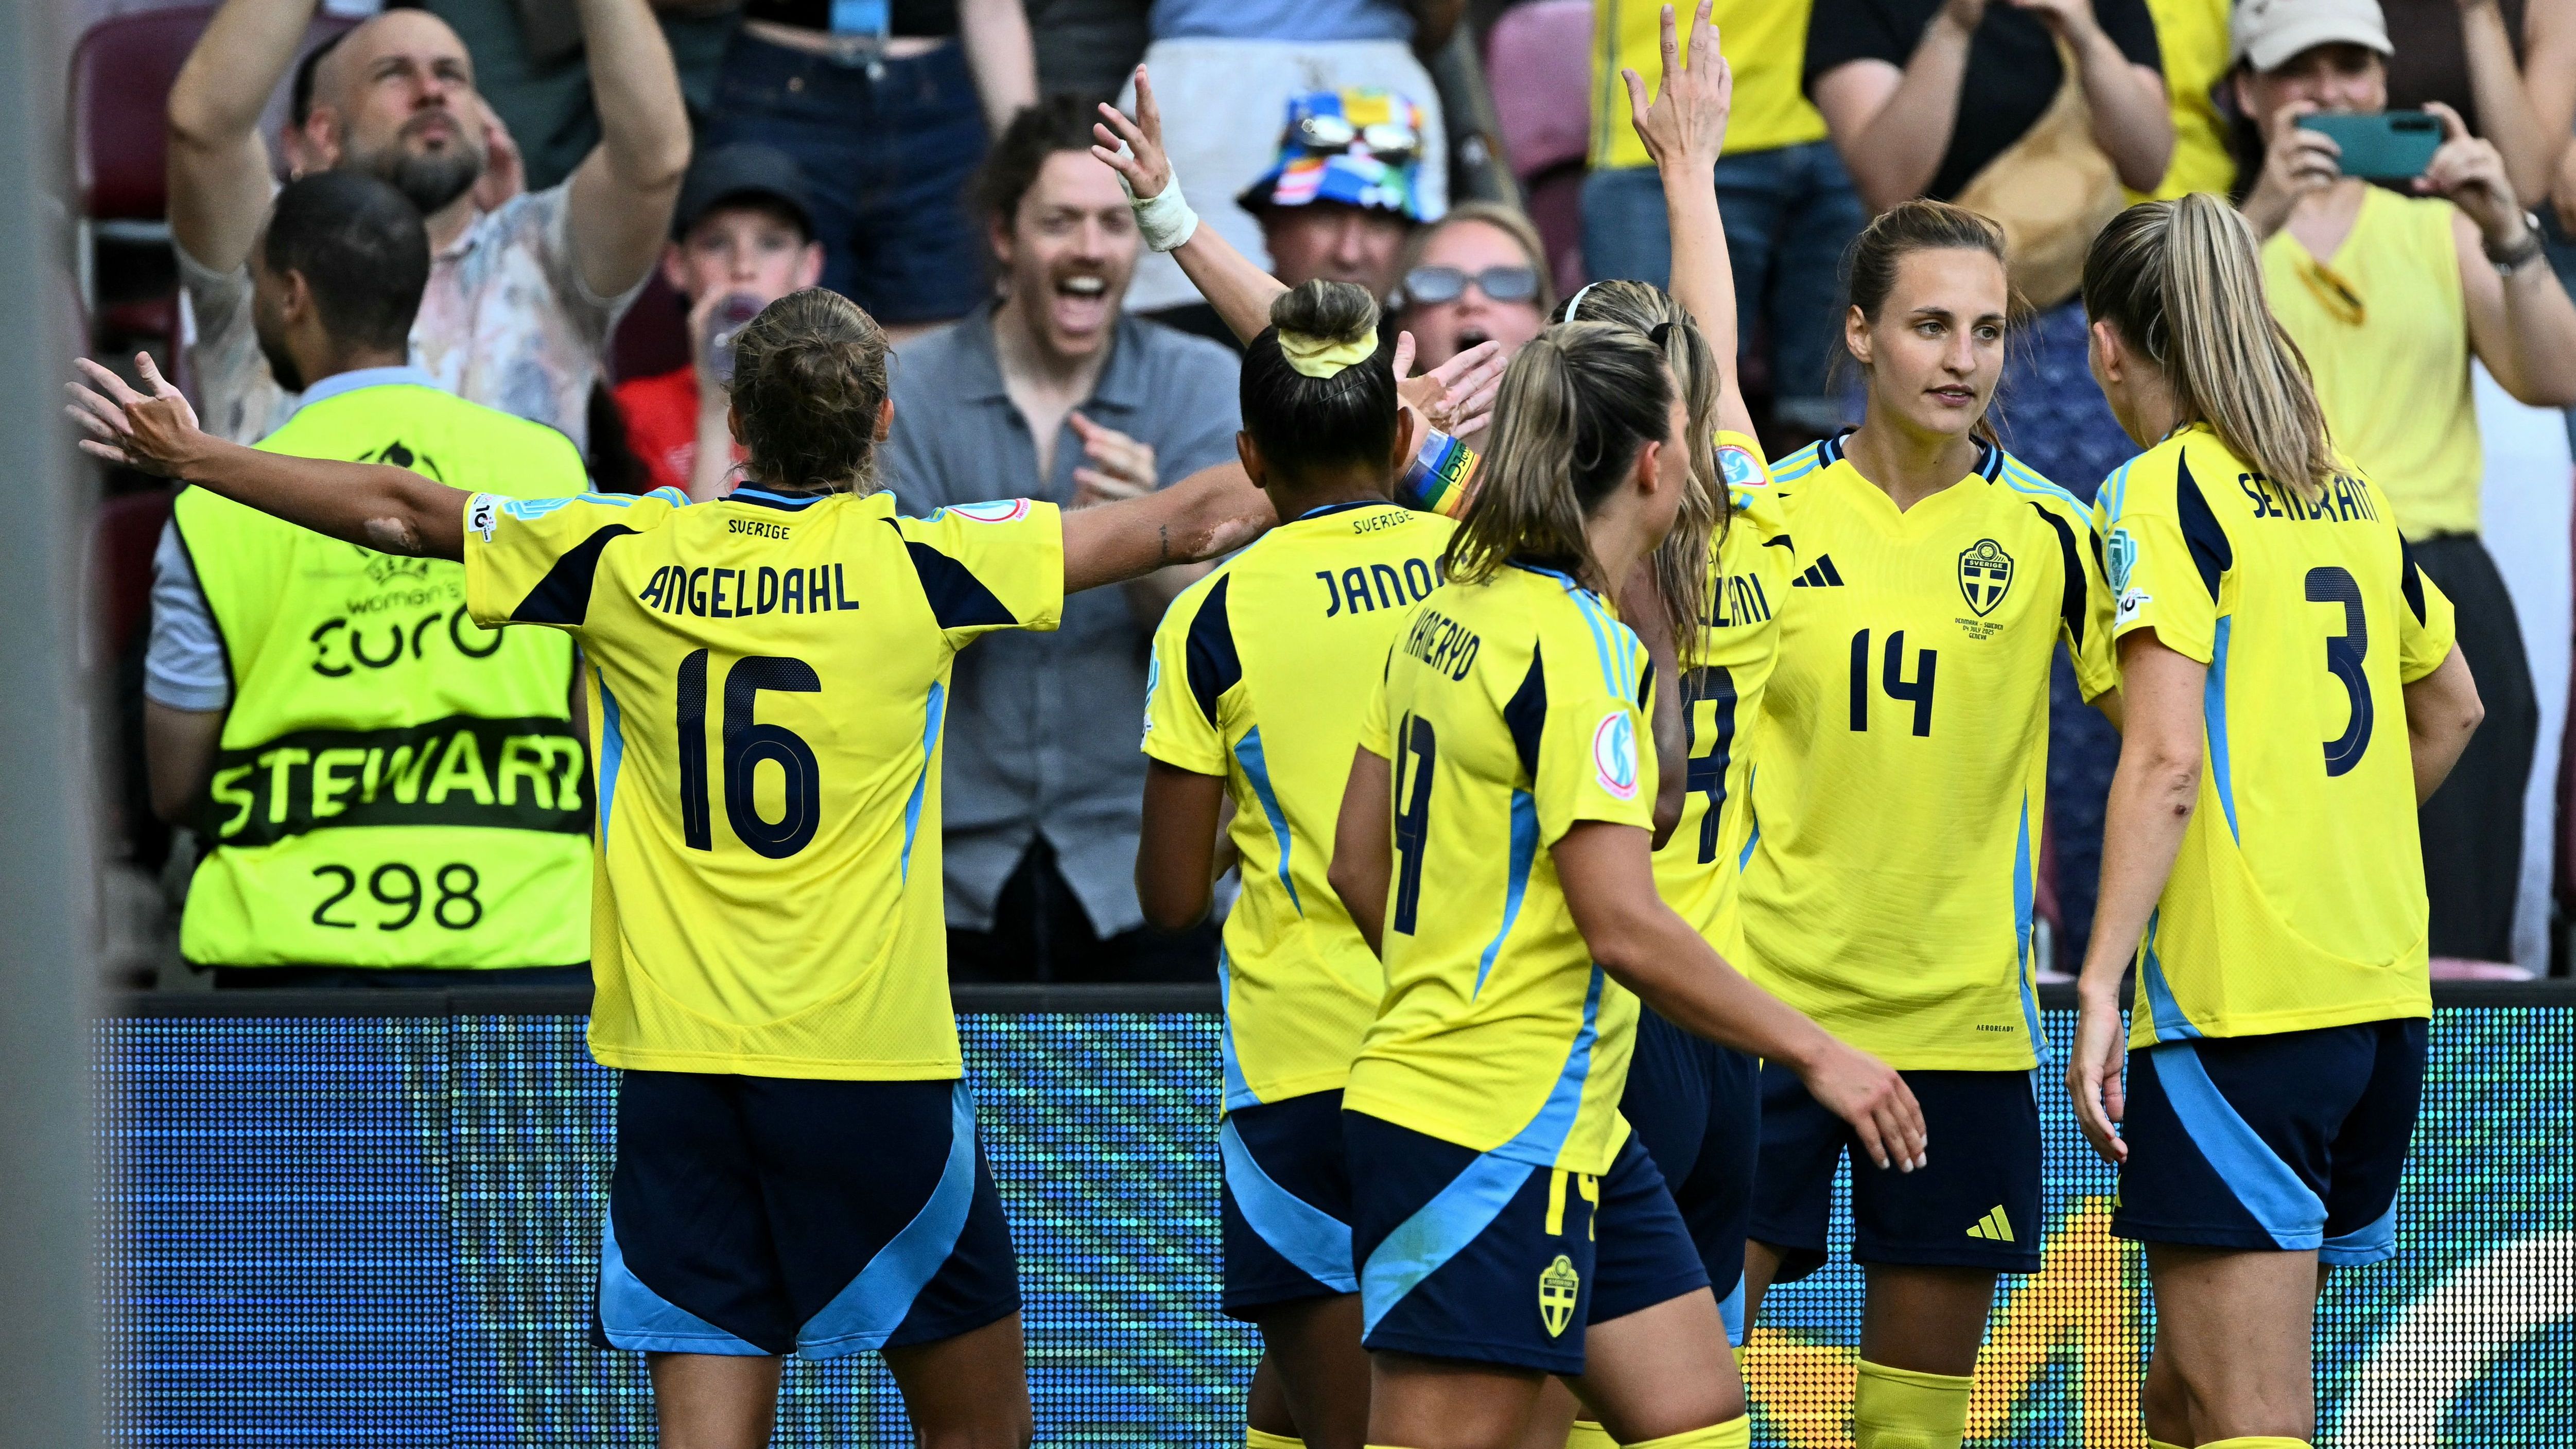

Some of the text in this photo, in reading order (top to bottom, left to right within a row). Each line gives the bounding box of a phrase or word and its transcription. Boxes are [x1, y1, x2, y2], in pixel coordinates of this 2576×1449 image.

[728, 519, 791, 540] SVERIGE
[1353, 509, 1415, 535] SVERIGE
[640, 563, 859, 618] ANGELDAHL
[1315, 553, 1467, 618] JANO
[1970, 560, 2003, 568] SVERIGE
[1955, 618, 1978, 626] DENMARK
[1984, 622, 2004, 631] SWEDEN
[1850, 628, 1938, 737] 14
[2305, 567, 2374, 777] 3
[211, 730, 585, 838] STEWARD
[677, 649, 821, 859] 16
[1679, 666, 1738, 864] 9
[311, 862, 481, 931] 298
